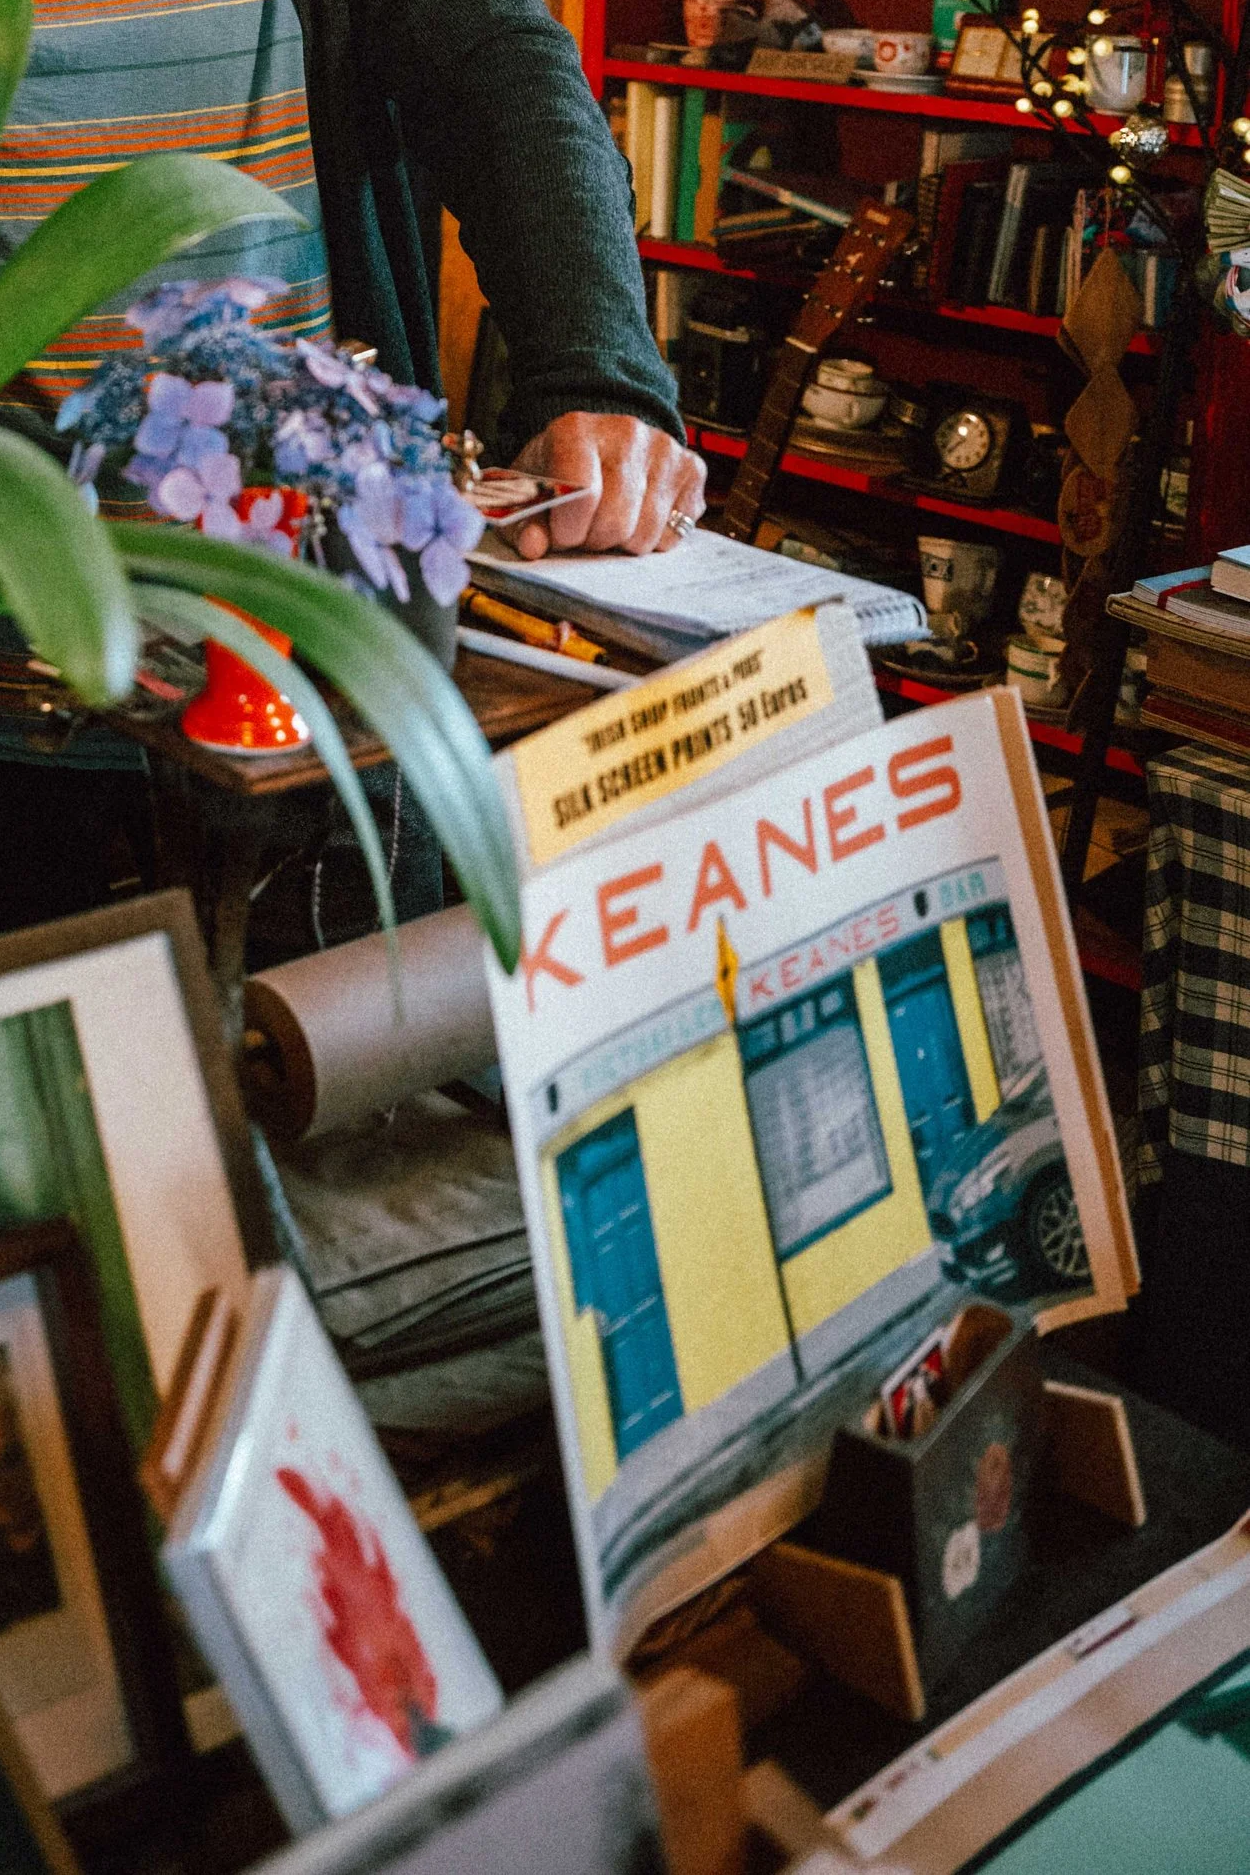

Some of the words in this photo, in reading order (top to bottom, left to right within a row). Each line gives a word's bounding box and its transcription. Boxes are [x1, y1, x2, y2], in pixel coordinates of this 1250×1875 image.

[552, 781, 593, 829] SILK
[597, 744, 668, 804] SCREEN
[671, 713, 732, 771] PRINTS
[737, 698, 758, 733] 50
[759, 676, 808, 721] Euros
[520, 733, 963, 1014] KEANES
[749, 903, 902, 1002] KEANES
